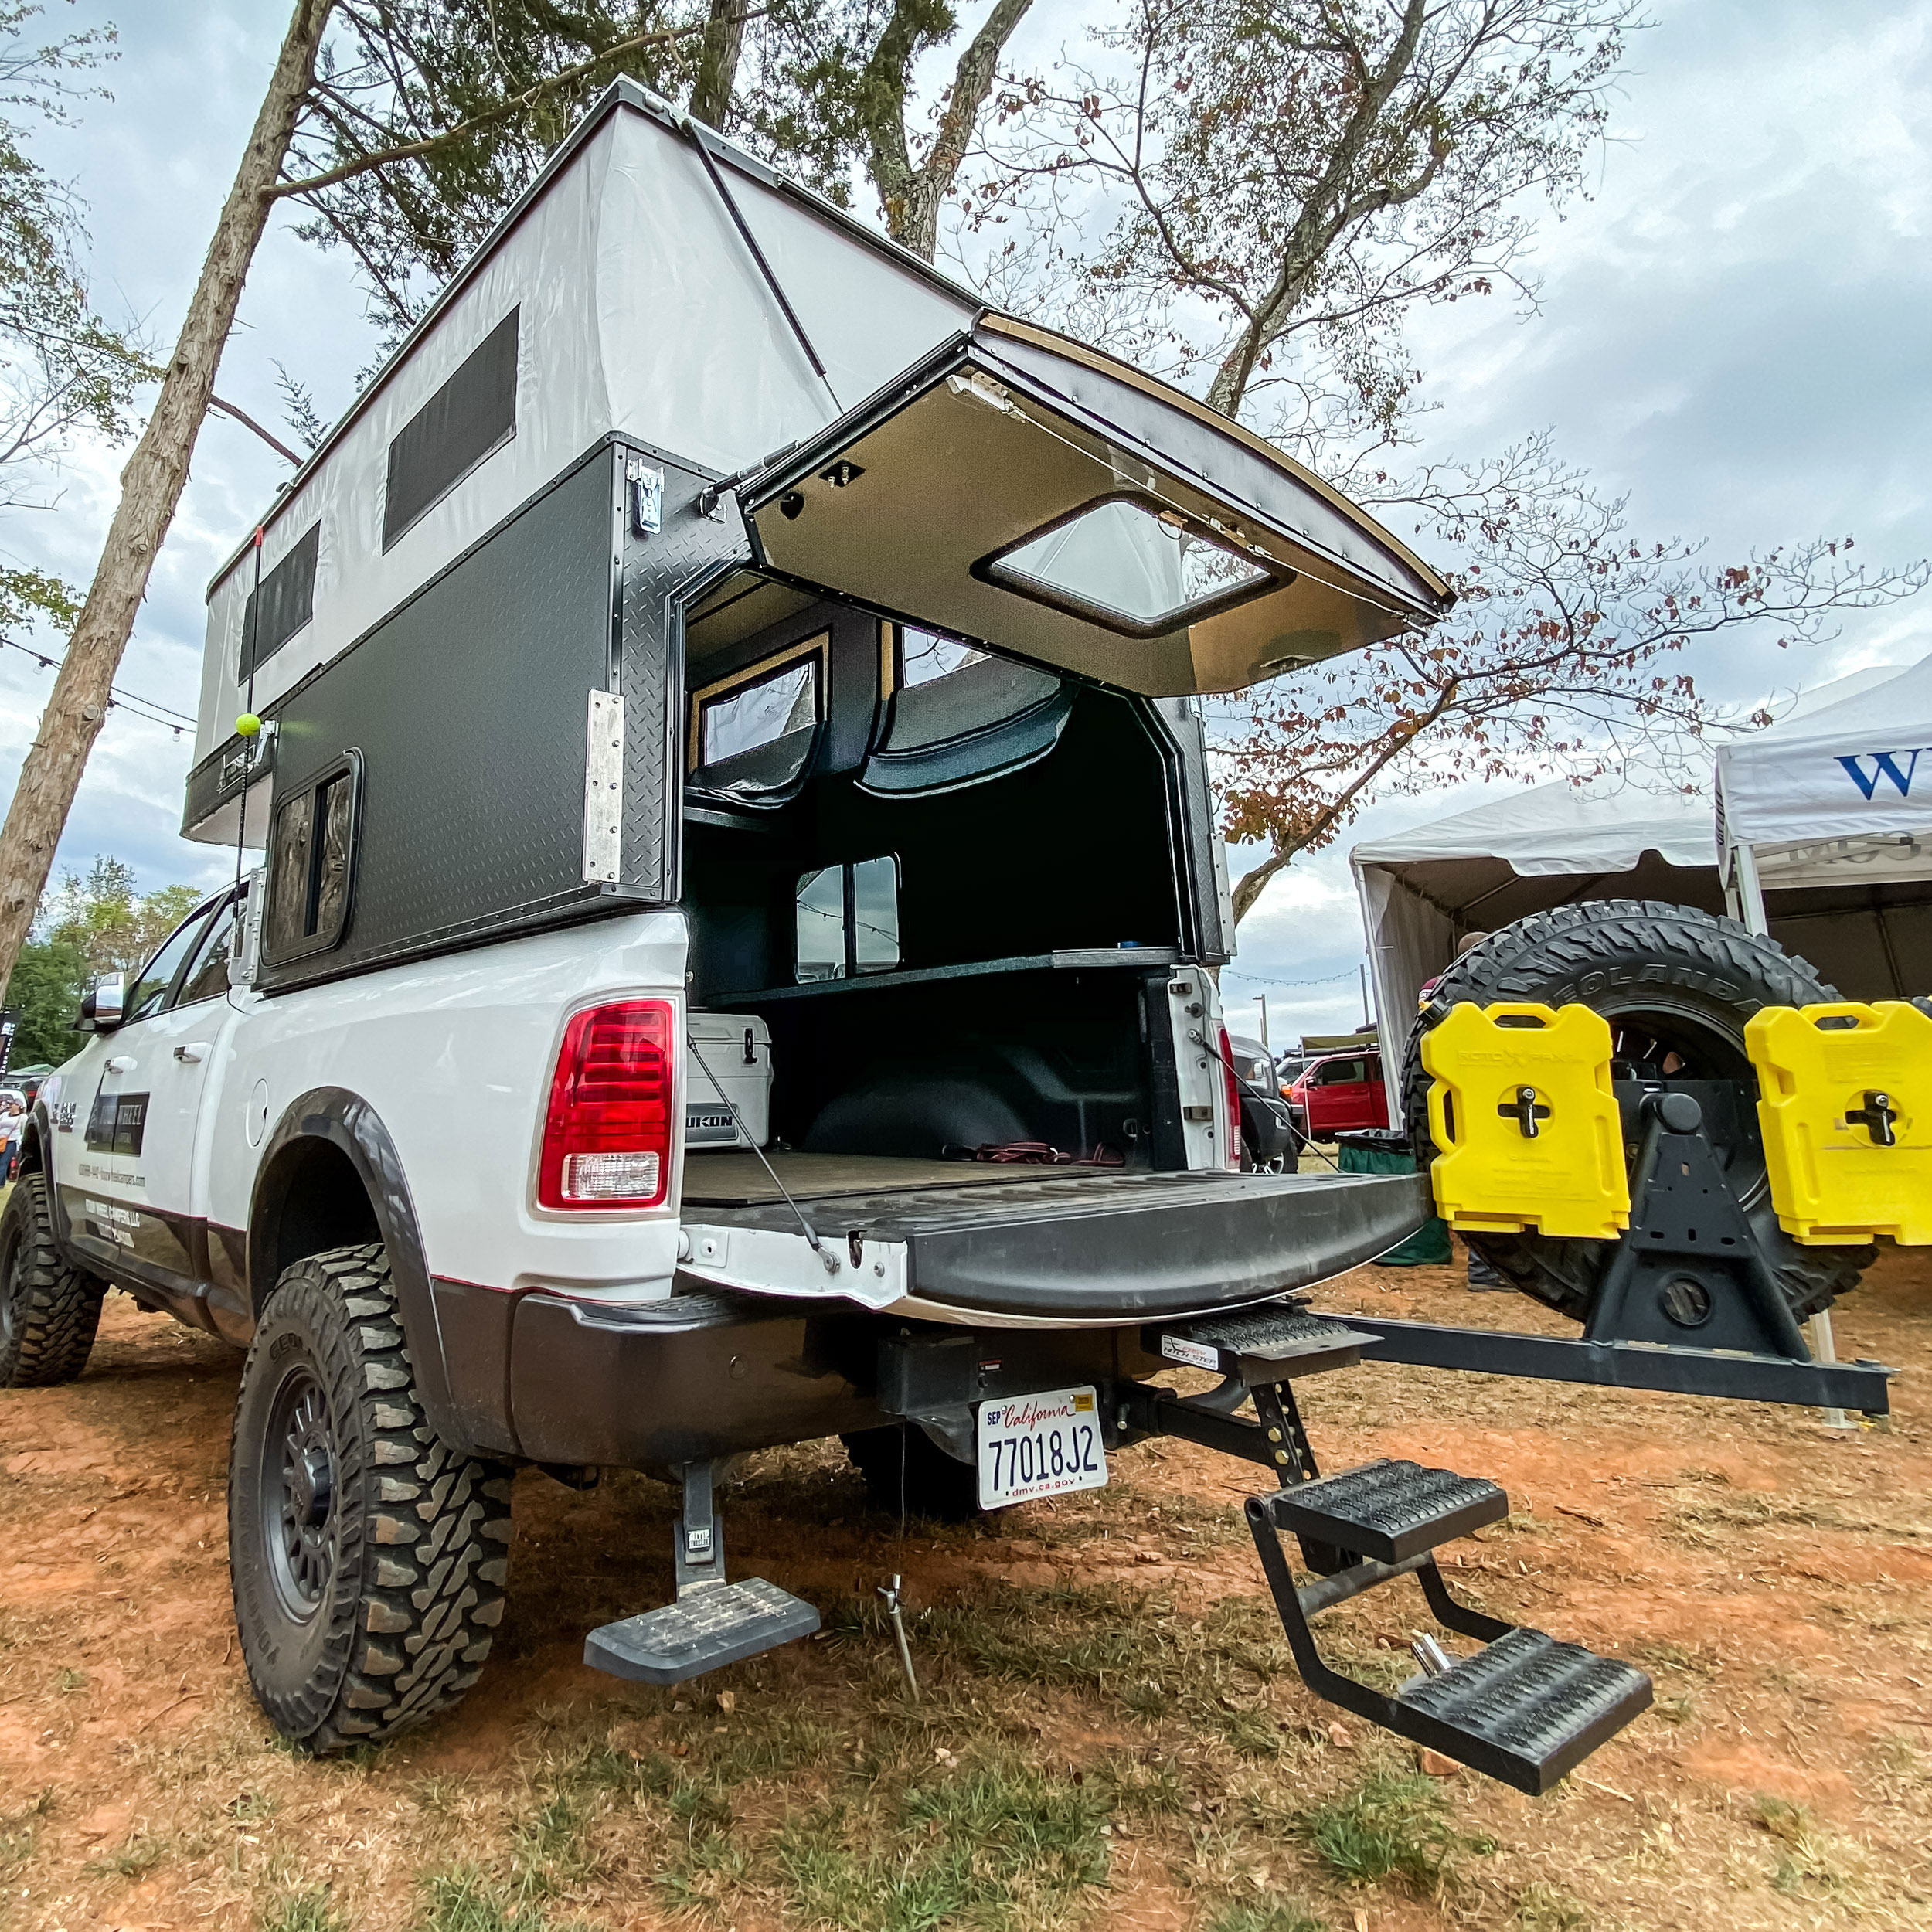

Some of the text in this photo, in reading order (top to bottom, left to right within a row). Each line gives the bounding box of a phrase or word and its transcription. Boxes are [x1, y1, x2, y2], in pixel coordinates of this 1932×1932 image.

[1833, 747, 1932, 801] W
[686, 1115, 733, 1128] UKON
[987, 1401, 1076, 1431] SEP California
[988, 1425, 1098, 1492] 77018J2
[1012, 1478, 1076, 1497] dmv.ca.gov
